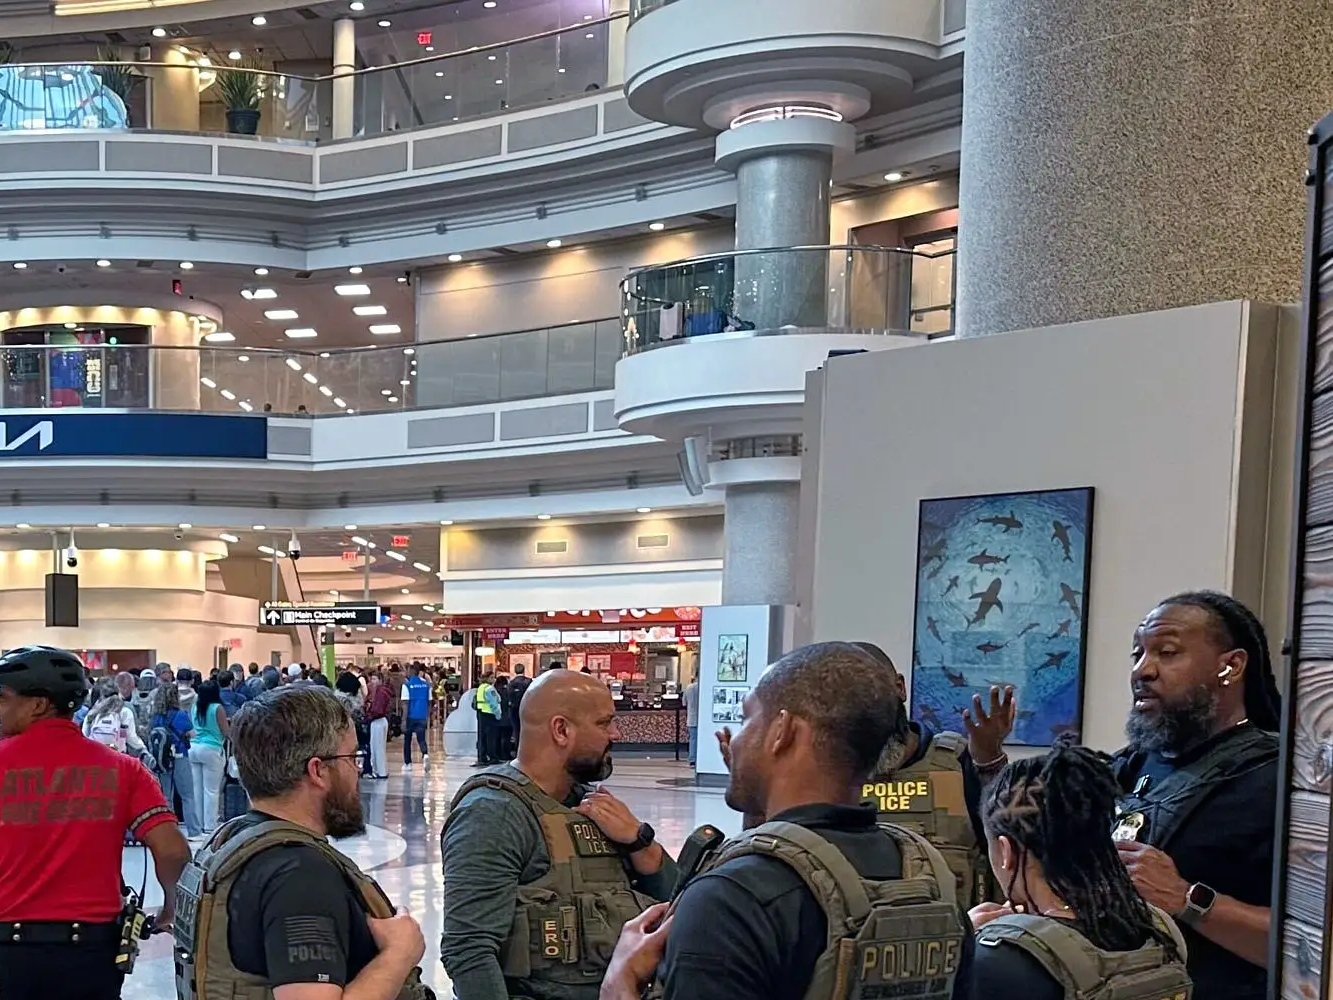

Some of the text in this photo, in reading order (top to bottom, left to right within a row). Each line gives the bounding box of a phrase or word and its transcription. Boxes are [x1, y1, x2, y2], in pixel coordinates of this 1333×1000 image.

[314, 611, 356, 620] Checkpoint
[0, 766, 119, 798] ATLANTA
[862, 781, 928, 797] POLICE
[880, 796, 910, 810] ICE
[588, 840, 610, 853] ICE
[544, 920, 559, 956] ERO
[860, 940, 958, 981] POLICE
